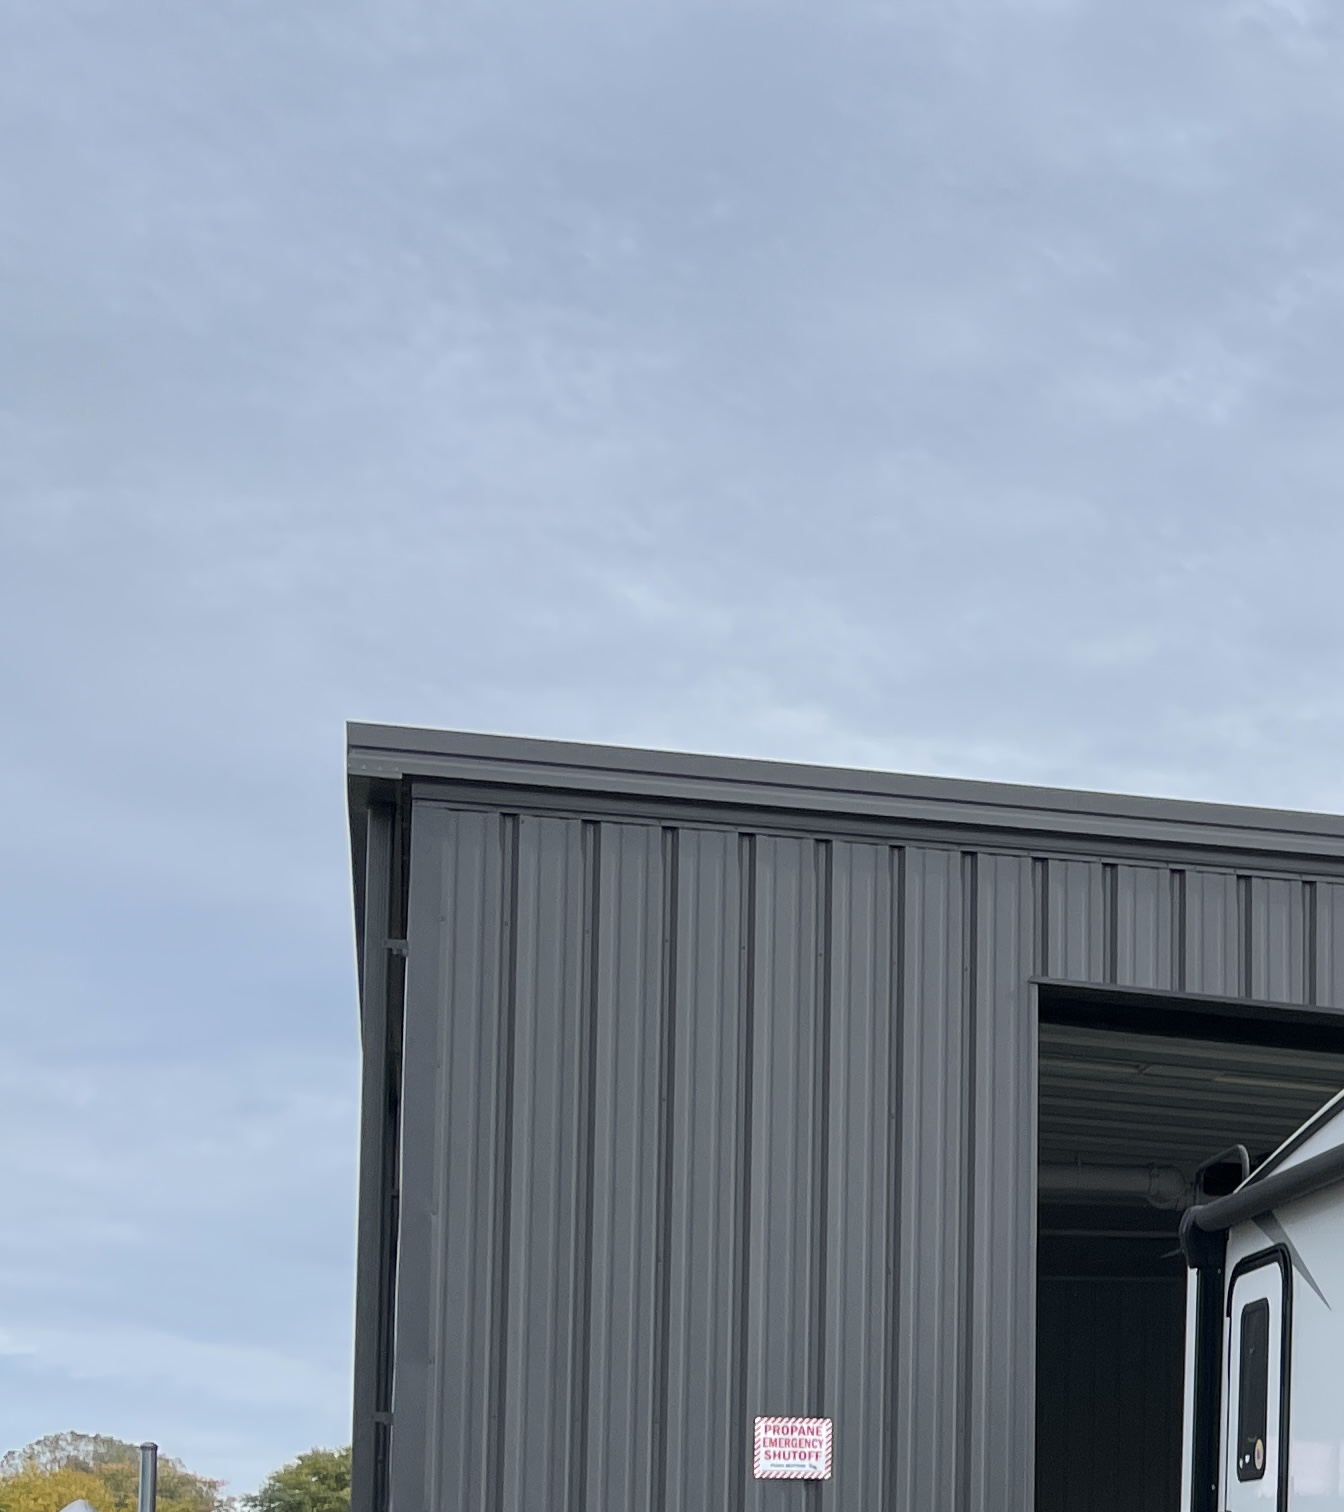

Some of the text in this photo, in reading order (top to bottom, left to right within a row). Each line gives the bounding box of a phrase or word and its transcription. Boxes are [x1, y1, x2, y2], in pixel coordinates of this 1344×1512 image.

[764, 1424, 823, 1437] PROPANE
[762, 1437, 824, 1449] EMERGENCY
[764, 1449, 823, 1461] SHUTOFF
